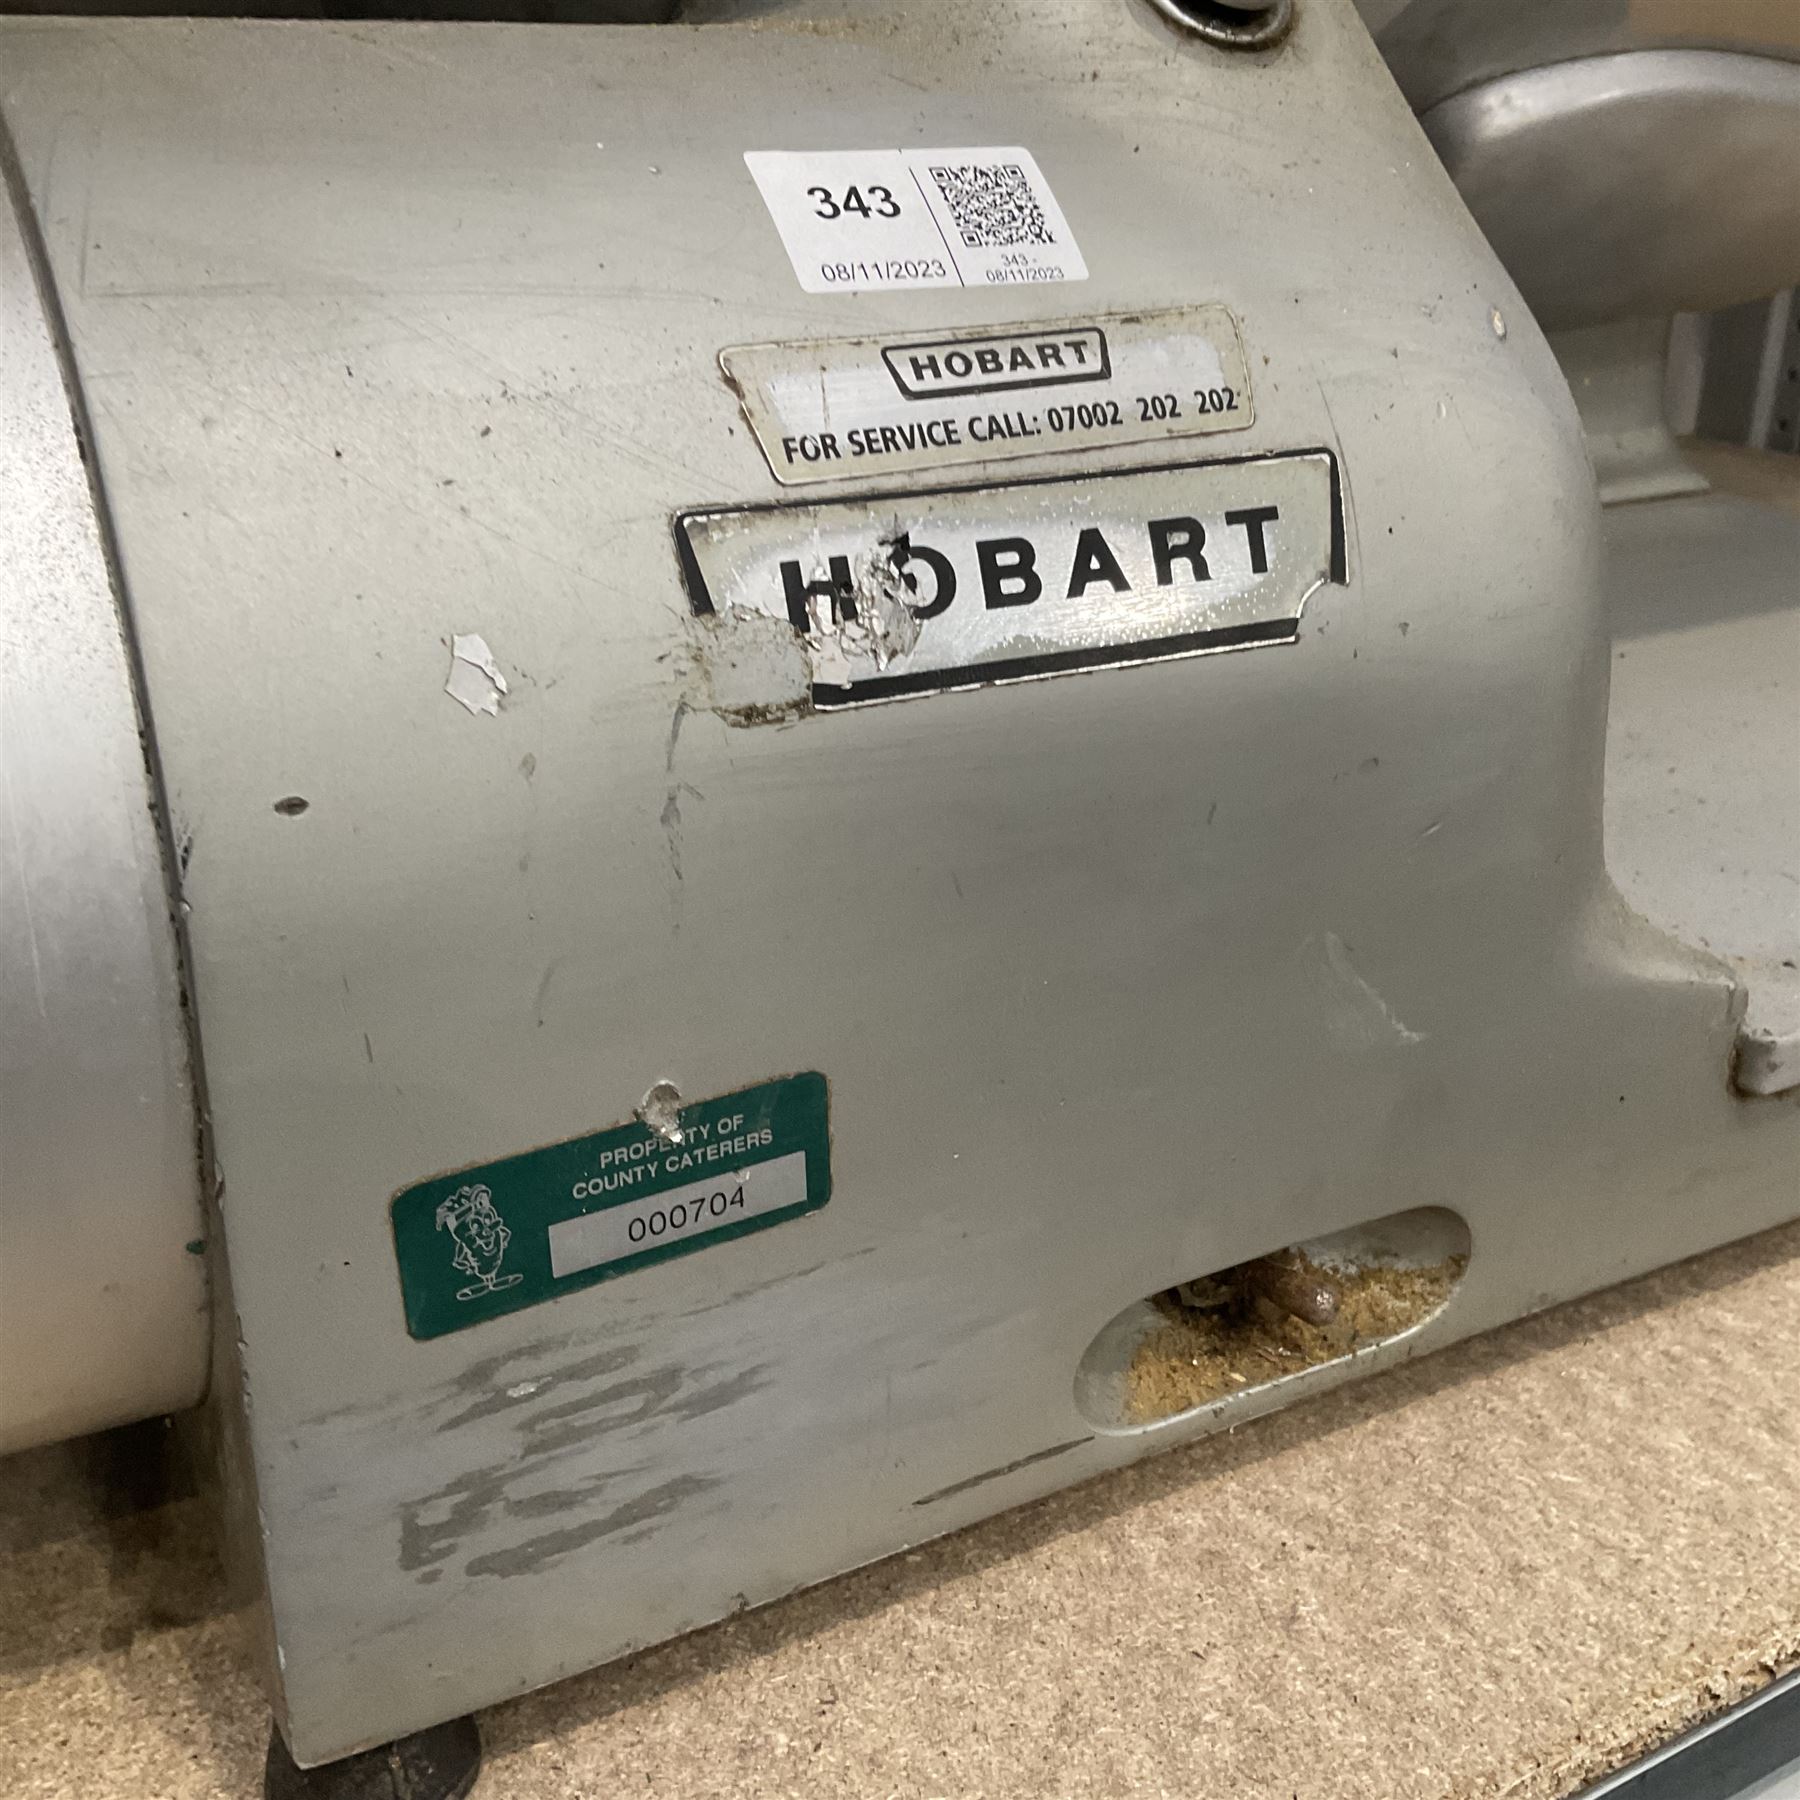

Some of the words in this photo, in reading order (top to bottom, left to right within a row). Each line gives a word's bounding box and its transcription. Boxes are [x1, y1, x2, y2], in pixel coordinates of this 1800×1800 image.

[806, 185, 902, 220] 343
[821, 260, 947, 283] 08/11/2023
[985, 266, 1065, 282] 08/11/2023
[1001, 253, 1028, 267] 343
[909, 340, 1090, 382] HOBART
[782, 435, 841, 465] FOR
[849, 420, 962, 458] SERVICE
[967, 413, 1042, 446] CALL:
[1047, 401, 1124, 434] 07002
[1139, 394, 1183, 423] 202
[1194, 386, 1238, 416] 202
[779, 506, 1280, 634] HOBART
[717, 1114, 744, 1134] OF
[572, 1160, 659, 1200] COUNTY
[665, 1128, 773, 1173] CATERERS
[628, 1185, 745, 1242] 000704
